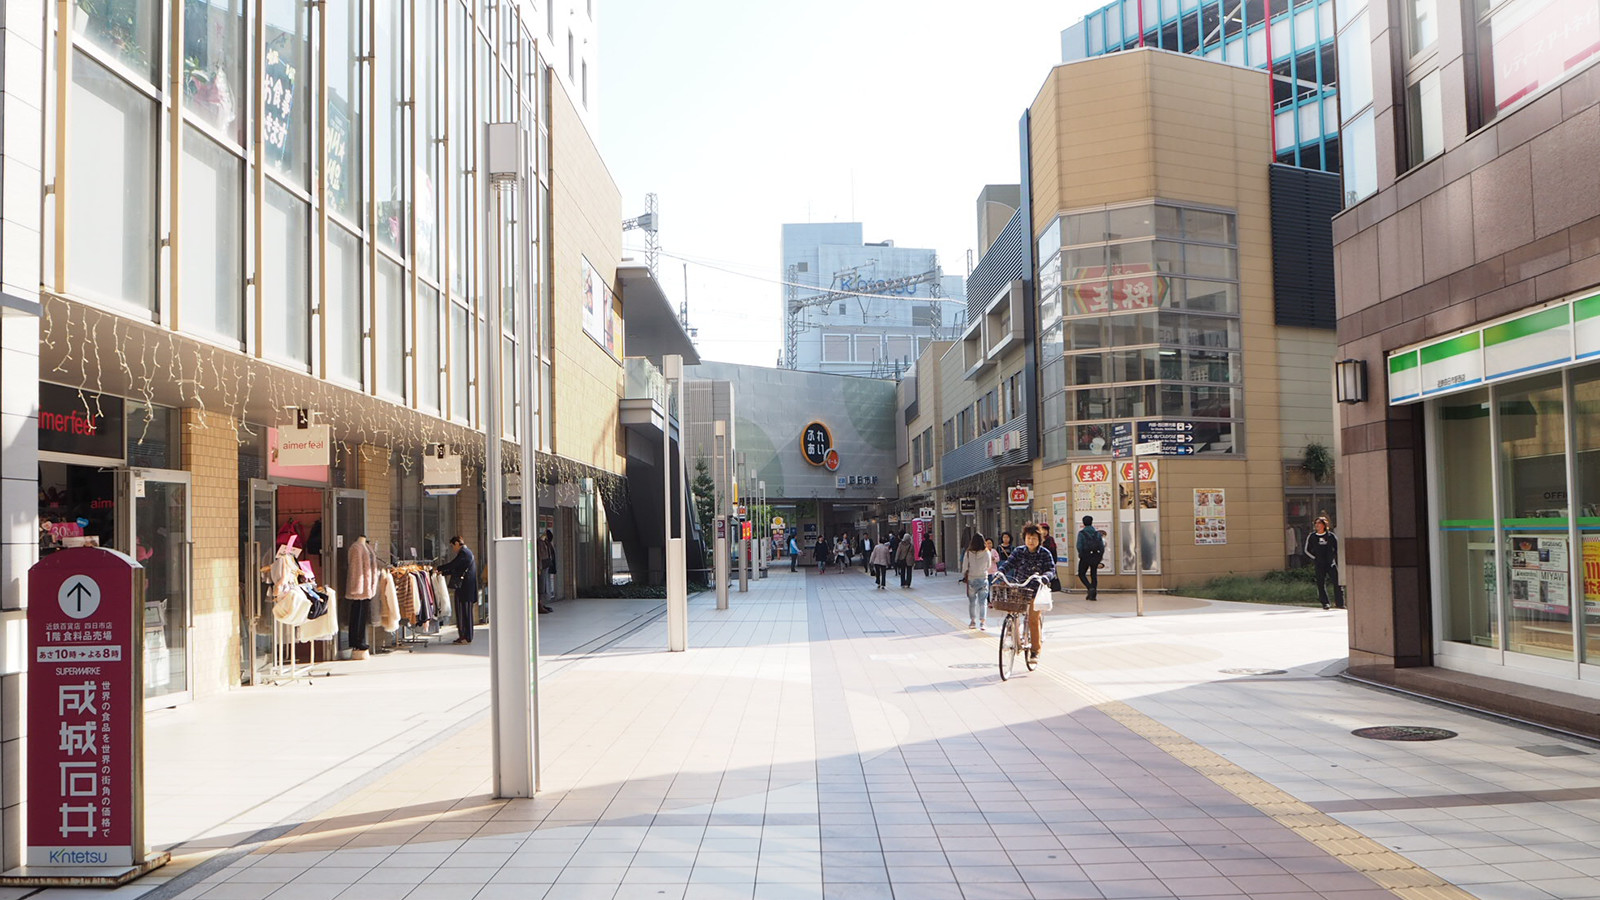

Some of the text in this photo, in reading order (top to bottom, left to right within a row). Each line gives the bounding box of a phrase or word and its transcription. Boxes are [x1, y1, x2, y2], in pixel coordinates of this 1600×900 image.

[1089, 282, 1151, 311] 王将
[38, 405, 96, 436] imerfeel
[807, 429, 825, 442] ふれ
[282, 441, 307, 450] aimer
[807, 442, 825, 455] あい
[1082, 470, 1104, 482] 王将
[45, 622, 113, 631] 近鉄百貨店 四日市店
[45, 630, 112, 642] 1階 食料品売場
[59, 680, 97, 838] 成城石井
[101, 680, 111, 838] 世界の食品を世界の街角の価格で
